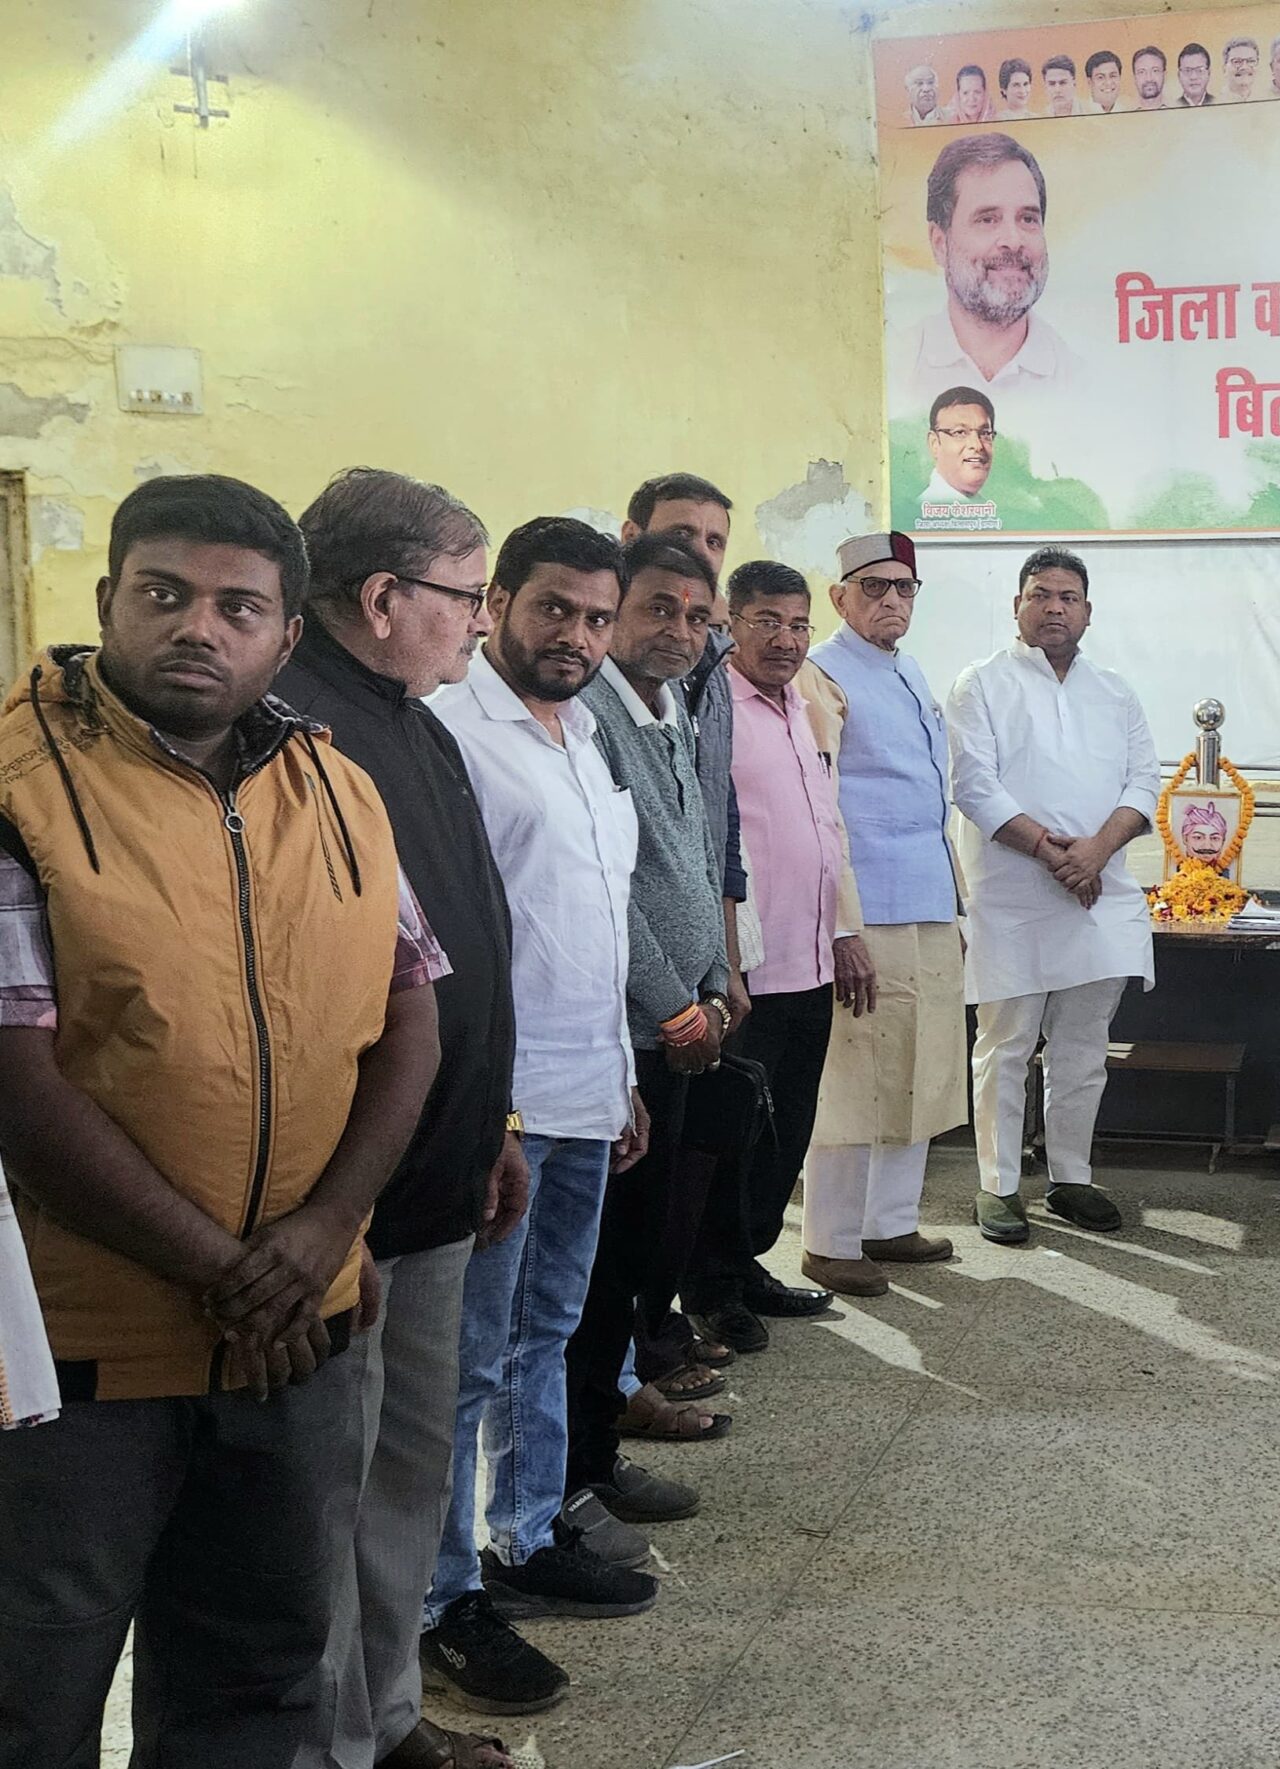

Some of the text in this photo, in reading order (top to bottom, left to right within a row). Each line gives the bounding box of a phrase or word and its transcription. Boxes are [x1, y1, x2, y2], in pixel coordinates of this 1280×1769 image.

[1115, 272, 1241, 343] जिला
[923, 502, 949, 516] विजय
[0, 743, 47, 777] UPERDRY
